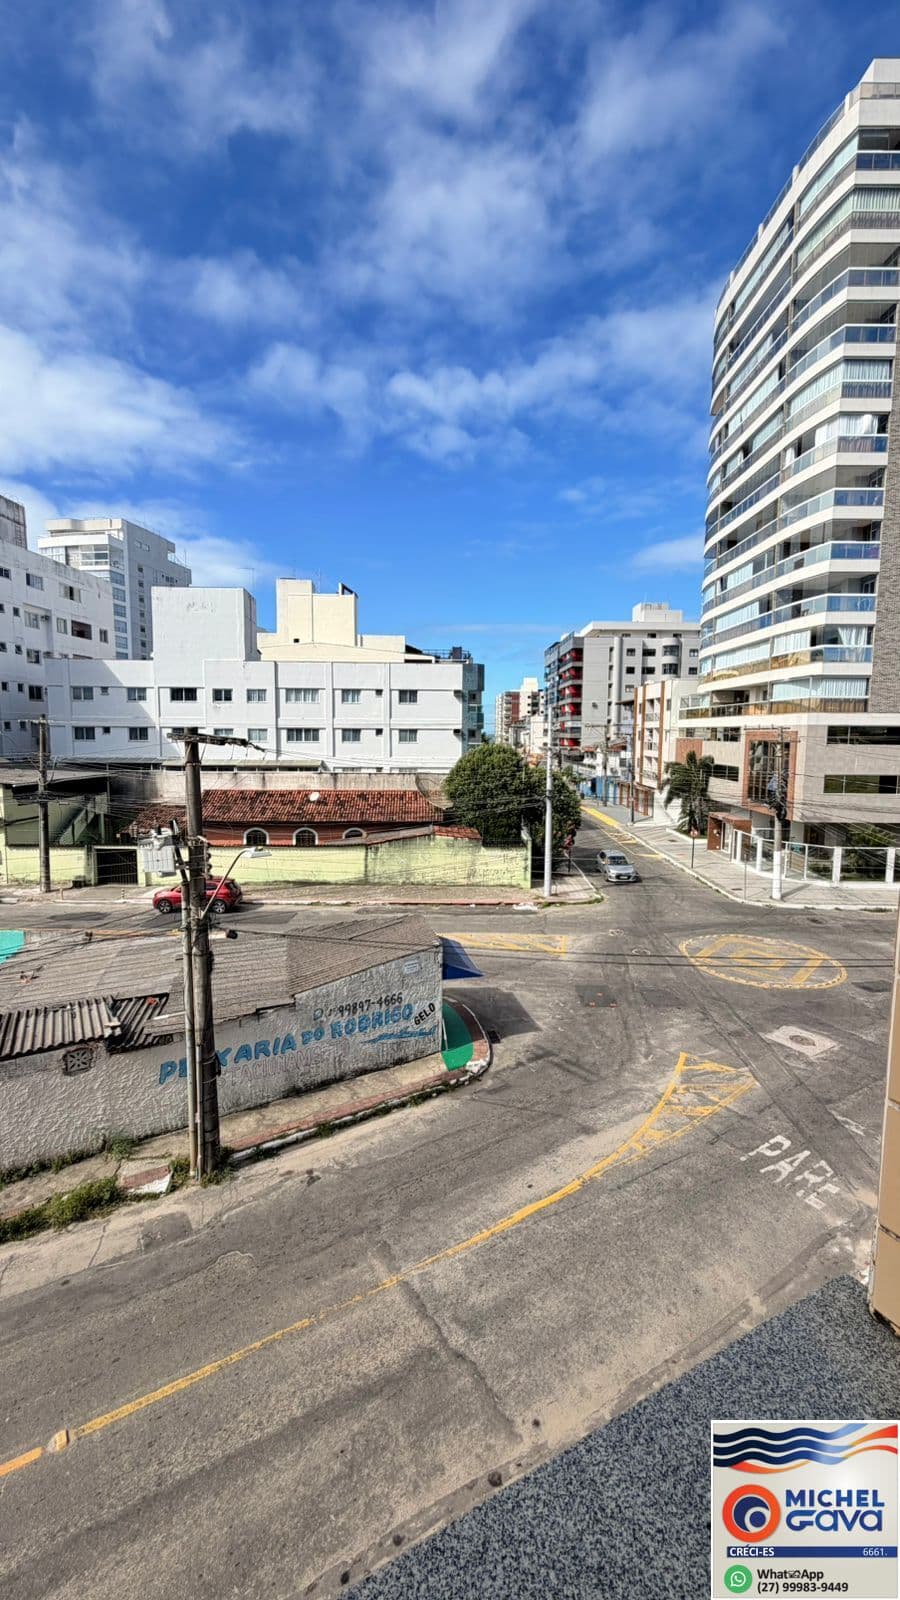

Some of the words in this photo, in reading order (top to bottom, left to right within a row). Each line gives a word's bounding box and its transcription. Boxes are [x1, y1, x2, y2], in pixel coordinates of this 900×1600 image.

[414, 1002, 436, 1026] GELO
[159, 1033, 297, 1085] PXARIA
[740, 1135, 840, 1209] PARE
